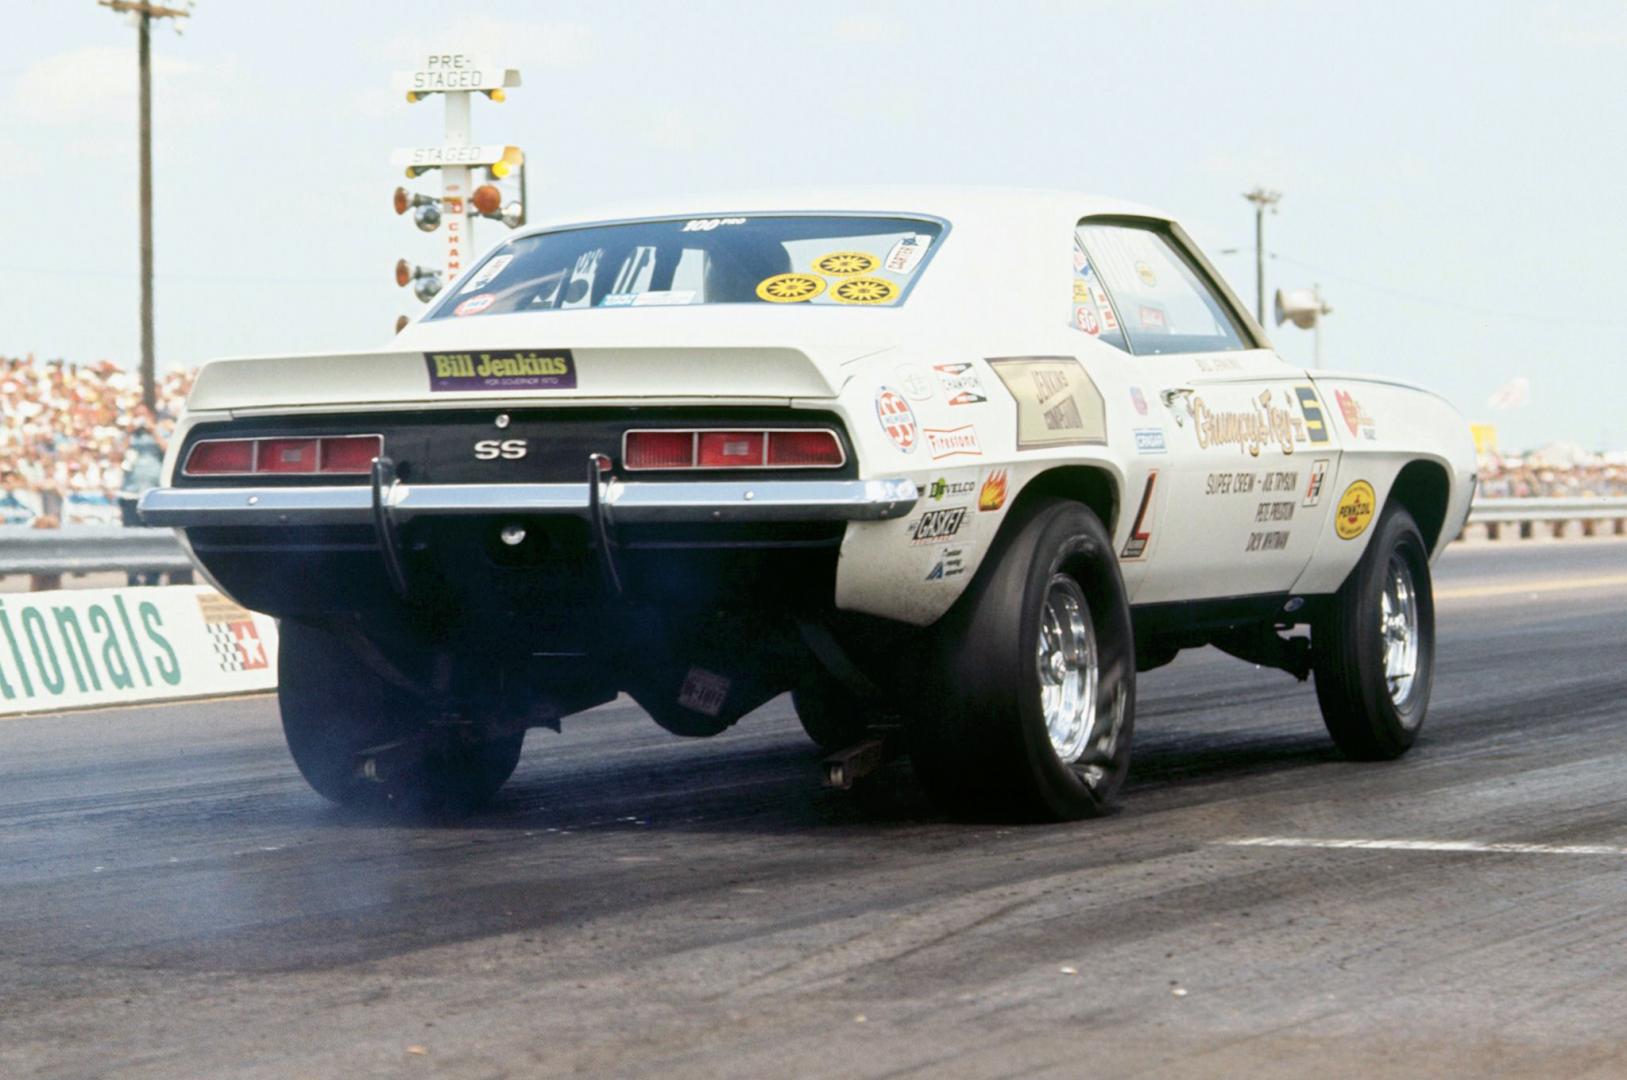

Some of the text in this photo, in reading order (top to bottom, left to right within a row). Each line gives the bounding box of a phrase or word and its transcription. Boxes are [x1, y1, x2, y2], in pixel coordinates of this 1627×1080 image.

[428, 55, 471, 69] PRE-
[414, 70, 481, 88] STAGED
[413, 146, 481, 163] STAGED
[433, 353, 569, 377] Bill Jenkins
[474, 439, 527, 460] SS
[1205, 472, 1233, 495] SUPER
[1233, 472, 1256, 494] CREW
[1339, 502, 1371, 518] PENNZOIL
[917, 508, 965, 538] GASKET
[0, 594, 181, 699] ionals
